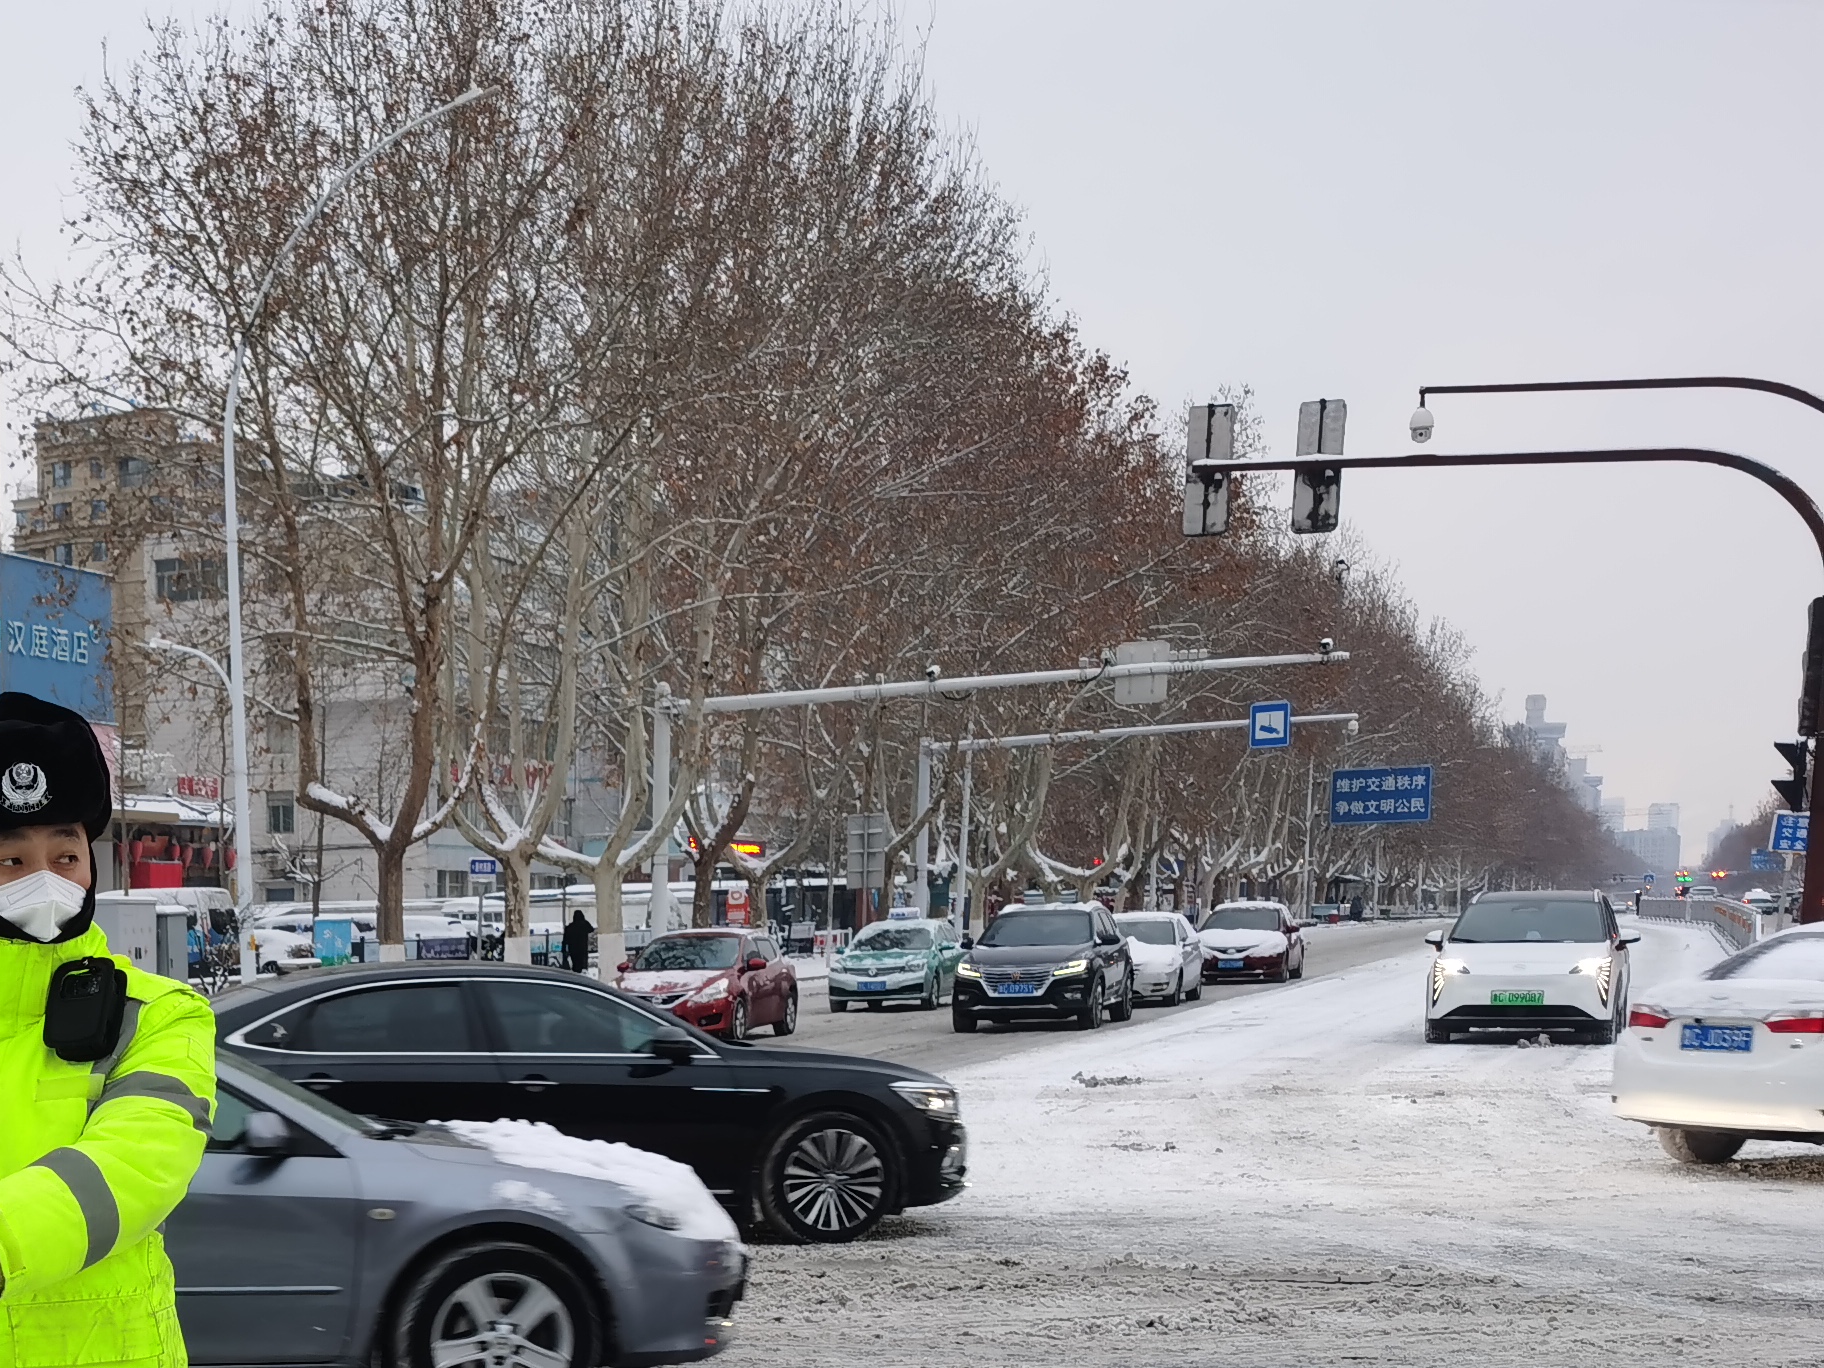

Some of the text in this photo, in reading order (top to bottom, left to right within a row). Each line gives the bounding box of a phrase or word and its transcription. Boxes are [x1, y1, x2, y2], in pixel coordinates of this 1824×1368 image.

[7, 620, 88, 664] 汉庭酒店
[1336, 774, 1426, 792] 维护交通秩序
[1335, 798, 1425, 815] 争做文明公民
